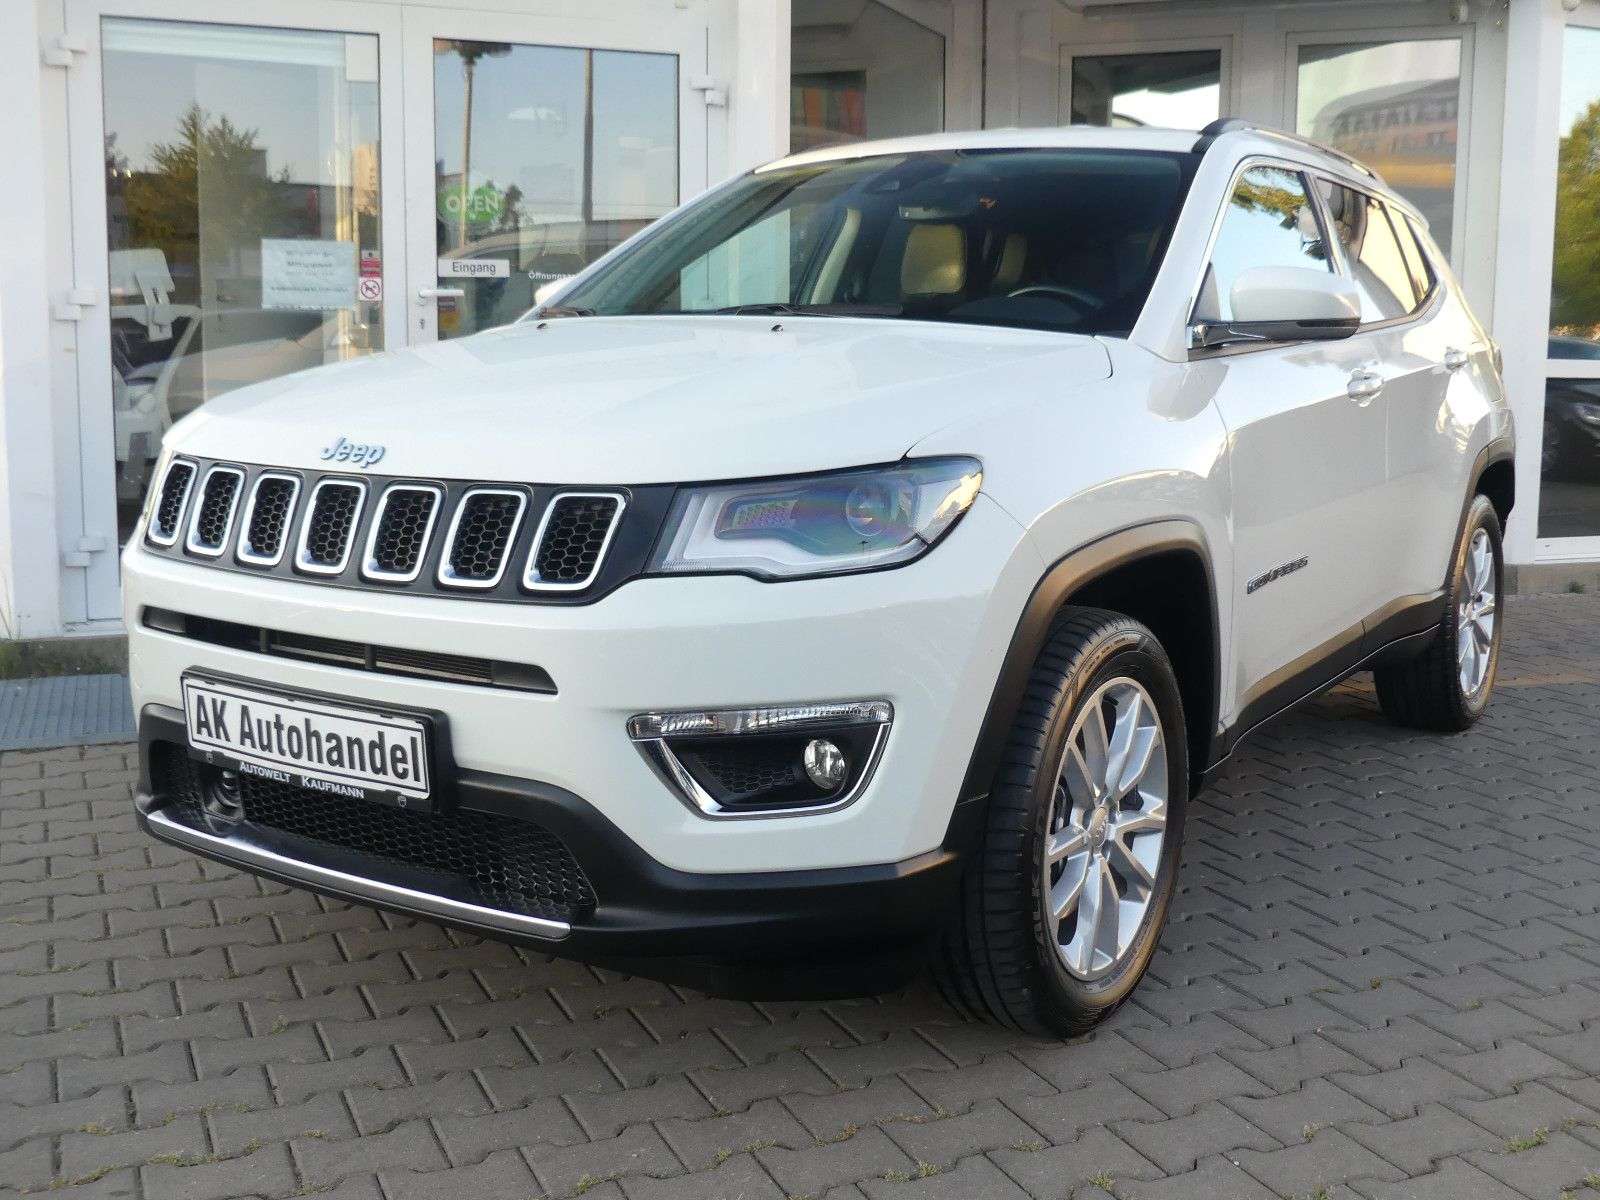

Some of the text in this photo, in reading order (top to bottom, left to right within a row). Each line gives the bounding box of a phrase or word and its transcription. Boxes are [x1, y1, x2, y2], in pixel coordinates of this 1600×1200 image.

[446, 194, 498, 213] OPEN
[452, 261, 497, 275] Eingang
[320, 437, 385, 468] Jeep
[196, 694, 421, 782] AK Autohandel
[239, 761, 365, 799] AUTOWELT KAUFMANN
